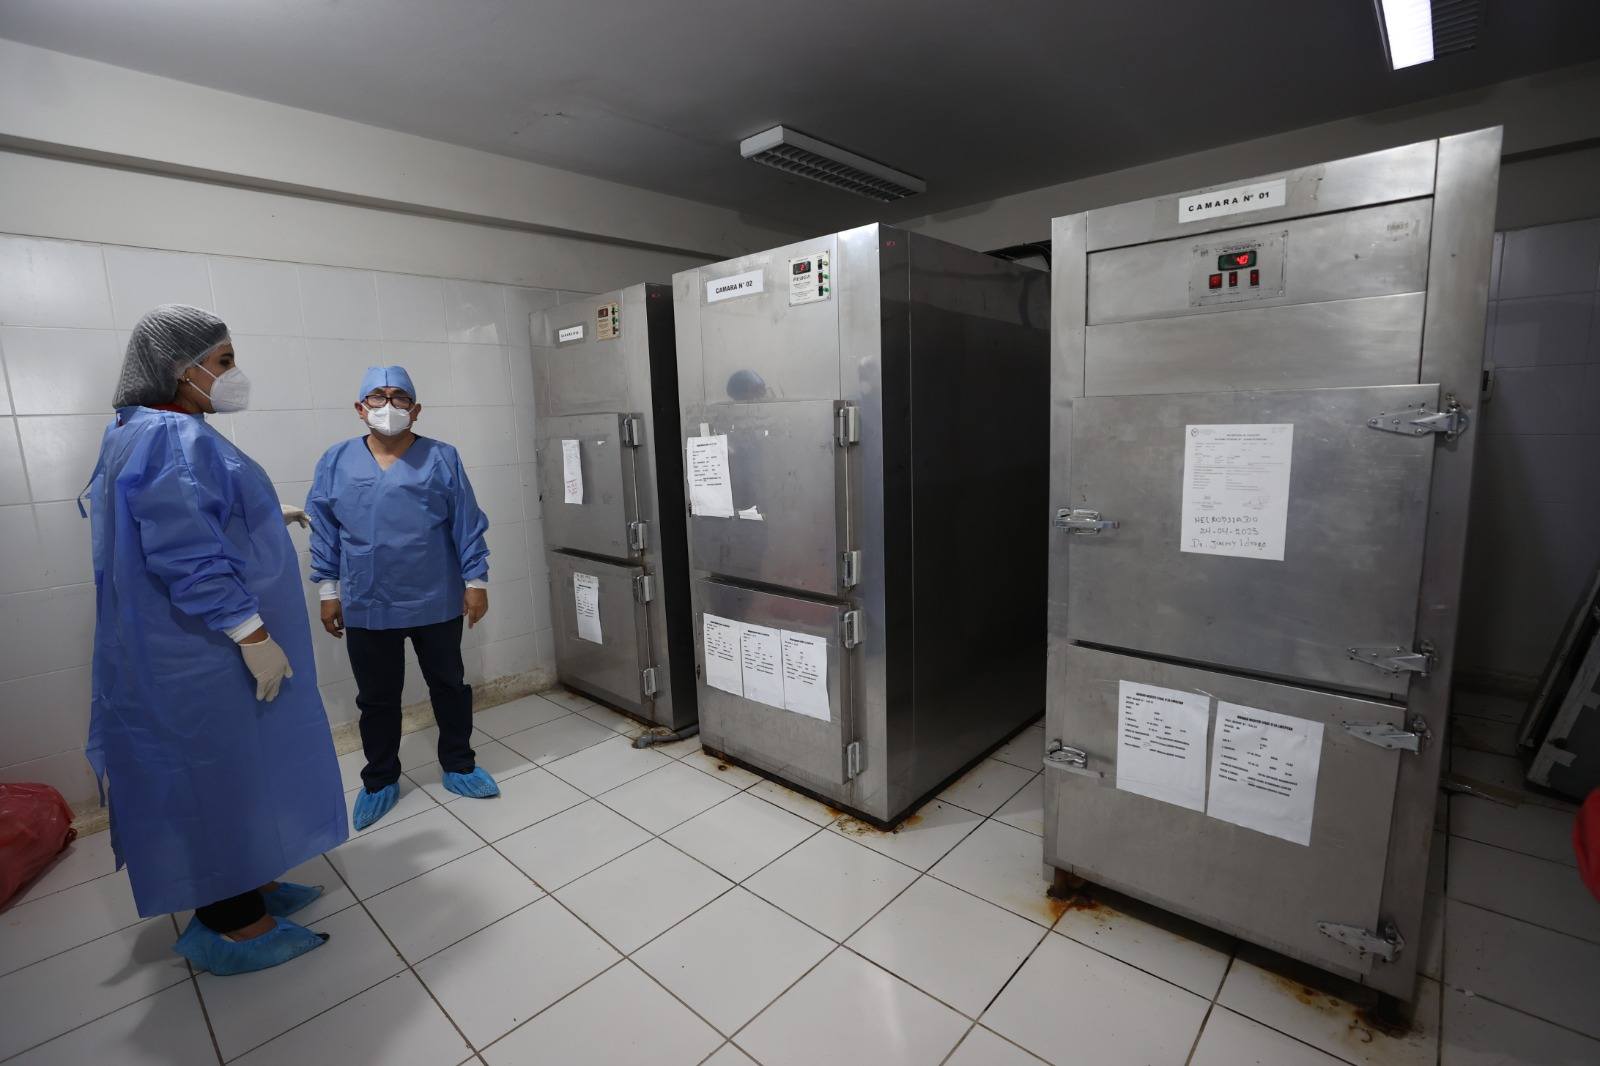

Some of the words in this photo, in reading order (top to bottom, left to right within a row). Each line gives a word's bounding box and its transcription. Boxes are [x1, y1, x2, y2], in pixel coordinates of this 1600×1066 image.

[1188, 197, 1238, 212] CAMARA
[1258, 191, 1270, 200] 01
[715, 284, 738, 294] CAMARA
